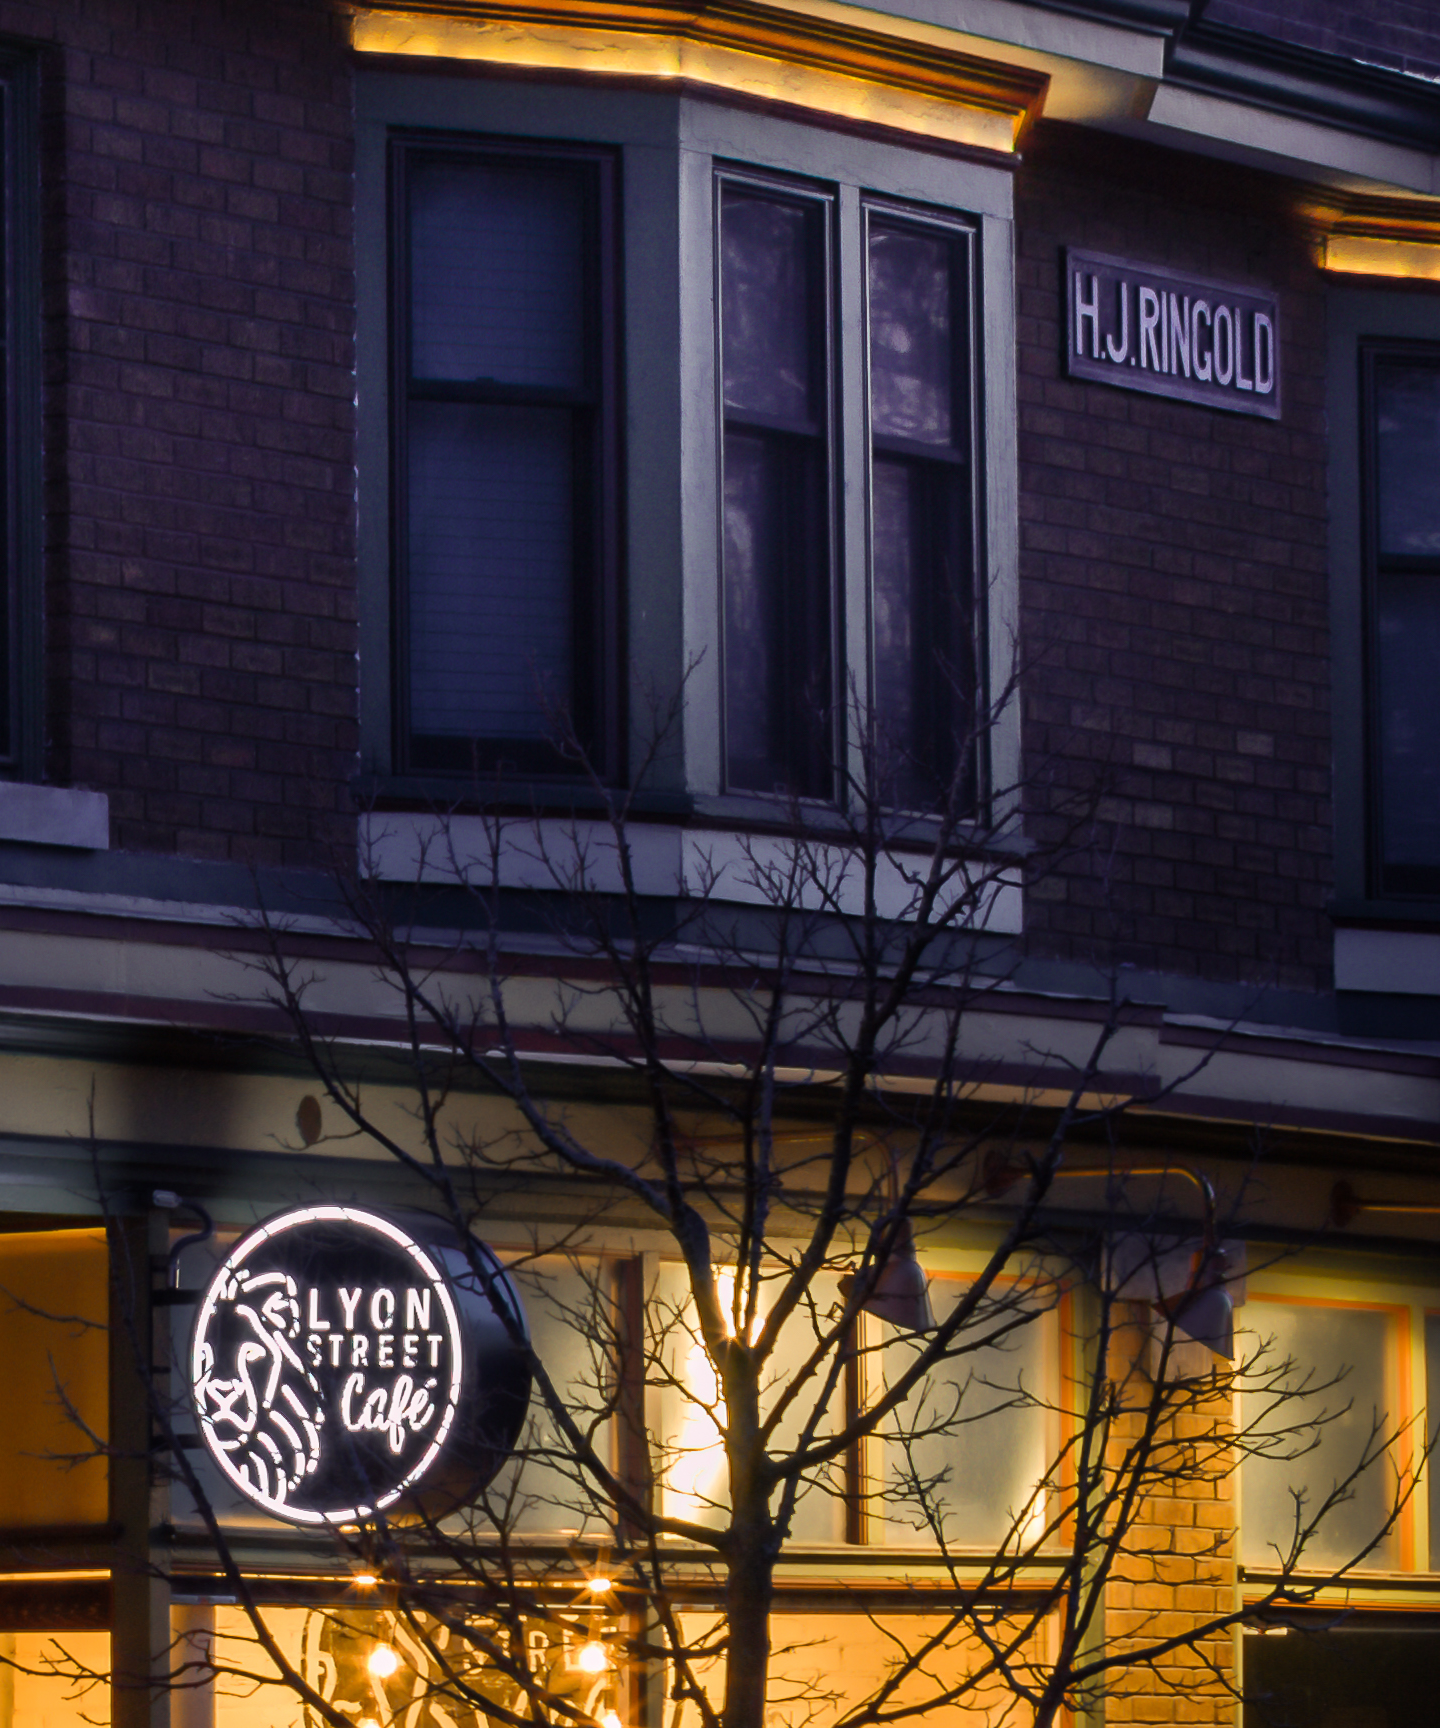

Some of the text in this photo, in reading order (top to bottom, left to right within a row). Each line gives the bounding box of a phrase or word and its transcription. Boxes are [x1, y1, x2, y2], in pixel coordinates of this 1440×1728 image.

[1139, 286, 1273, 394] RINGOLD
[305, 1287, 432, 1332] LYON
[305, 1334, 444, 1368] STREET
[340, 1372, 439, 1456] Café
